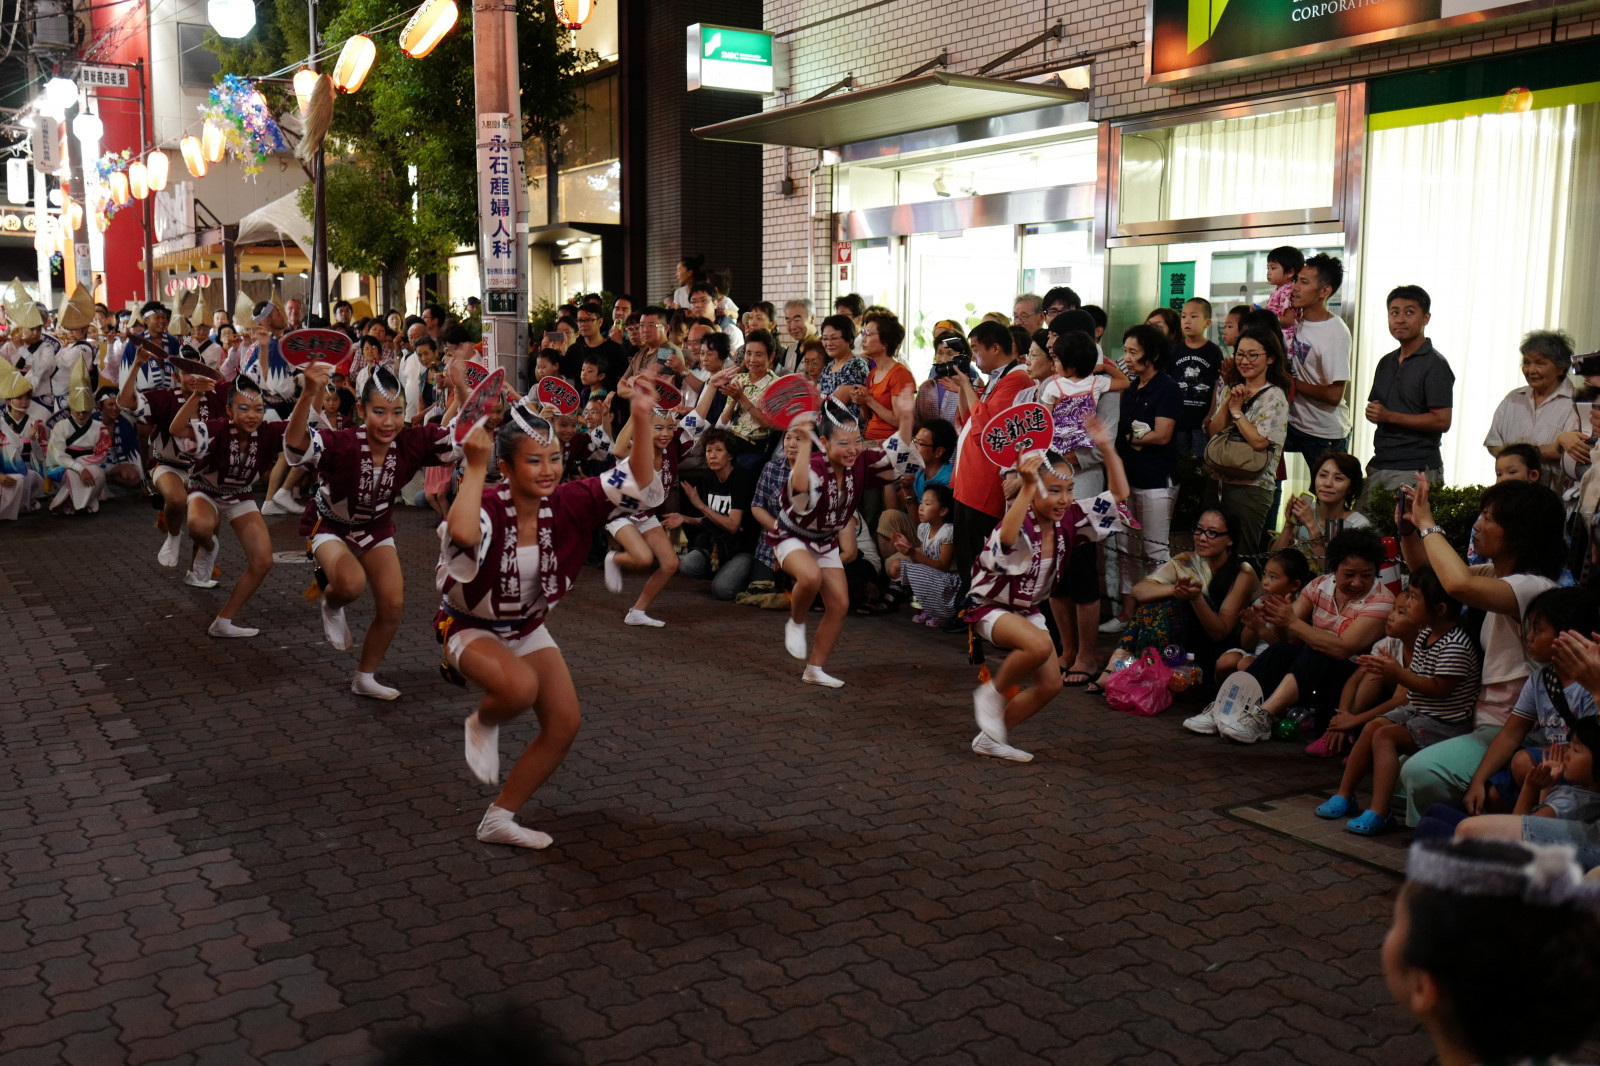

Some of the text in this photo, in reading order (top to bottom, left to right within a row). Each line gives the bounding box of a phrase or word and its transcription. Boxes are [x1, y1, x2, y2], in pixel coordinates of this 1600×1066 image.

[488, 134, 512, 259] 永石産婦人科
[1175, 355, 1211, 369] POLICE VEHICLES
